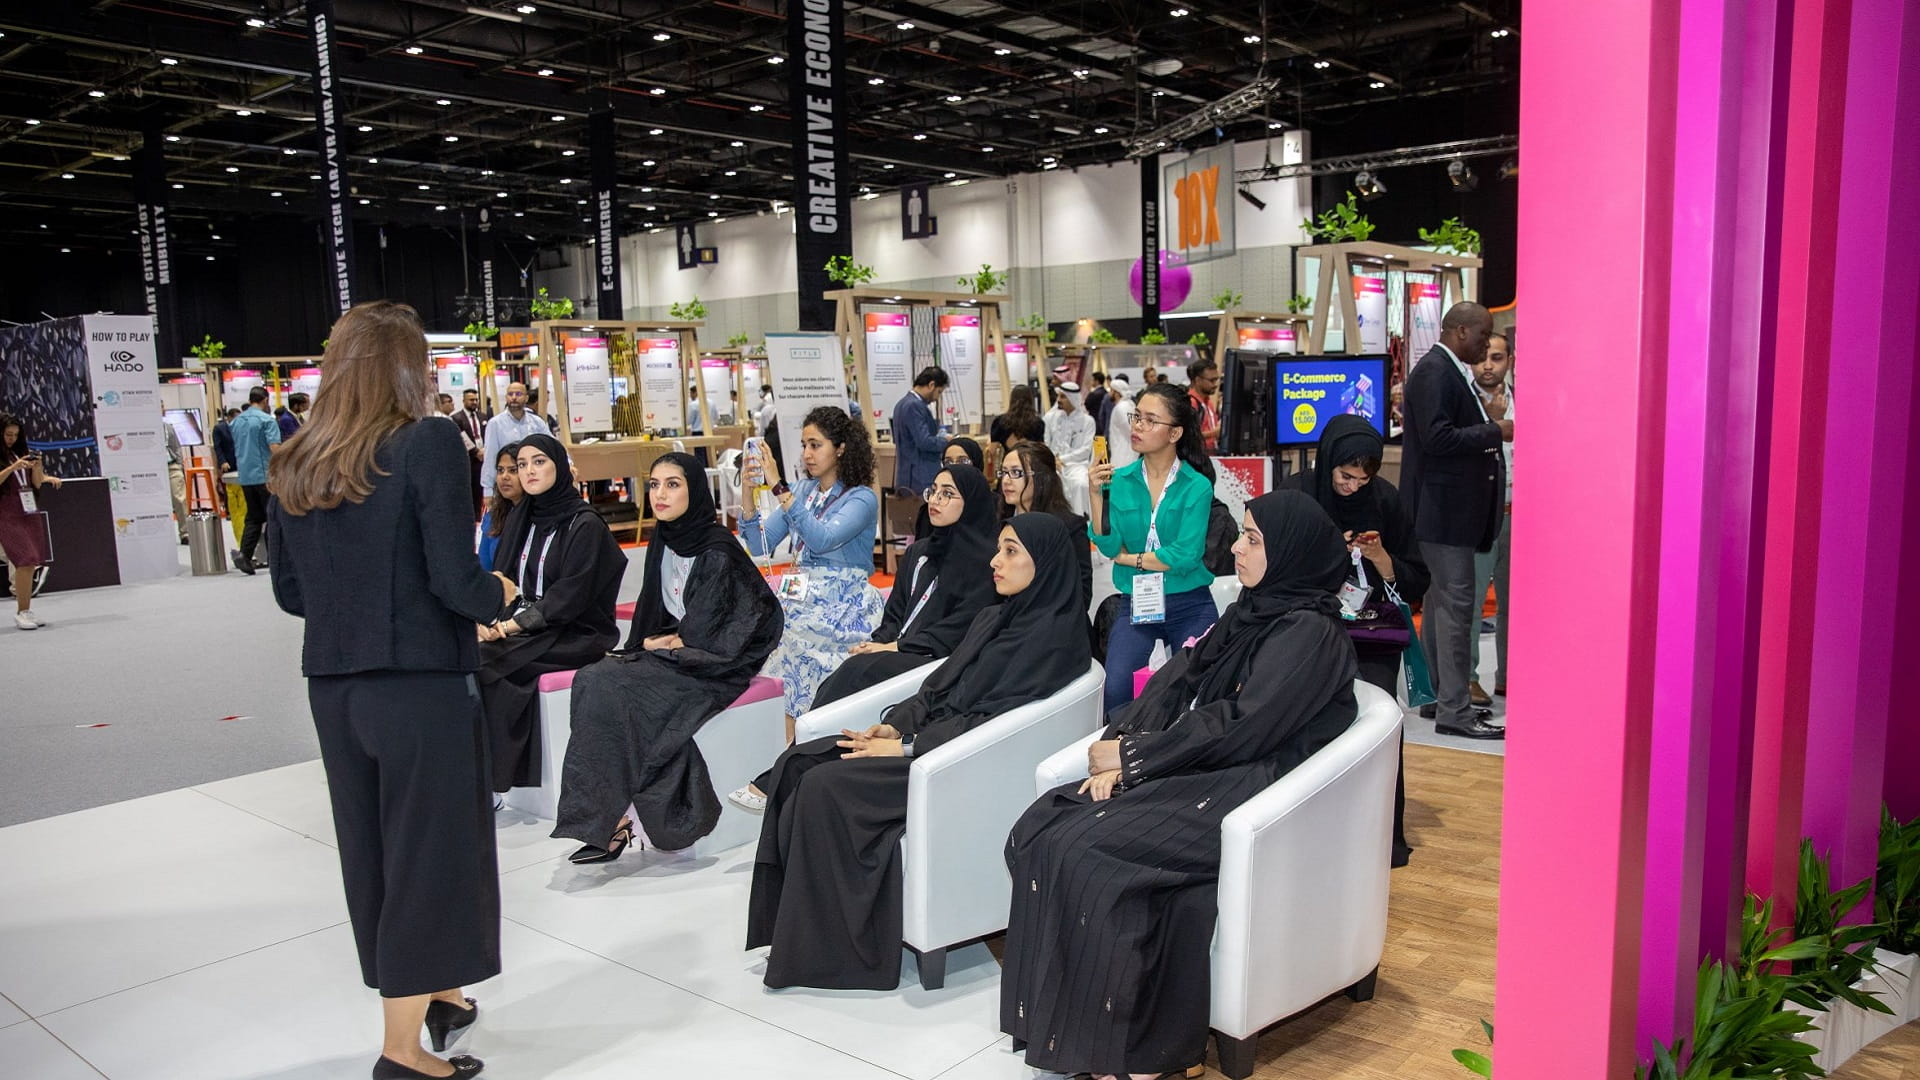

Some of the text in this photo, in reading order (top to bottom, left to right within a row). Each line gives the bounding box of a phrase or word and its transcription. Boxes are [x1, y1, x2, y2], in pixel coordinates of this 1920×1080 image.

[807, 95, 838, 234] CREATIVE
[332, 203, 344, 246] TECH
[599, 190, 614, 291] E-COMMERCE
[1174, 165, 1221, 251] 10X
[154, 205, 170, 285] MOBILITY
[1146, 201, 1156, 305] CONSUMER TECH
[337, 250, 351, 316] ERSIVE
[483, 260, 495, 329] BLOCKCHAIN
[92, 332, 150, 342] HOW TO PLAY
[104, 363, 144, 372] HADO
[1283, 373, 1346, 384] E-Commerce
[1283, 388, 1326, 401] Package
